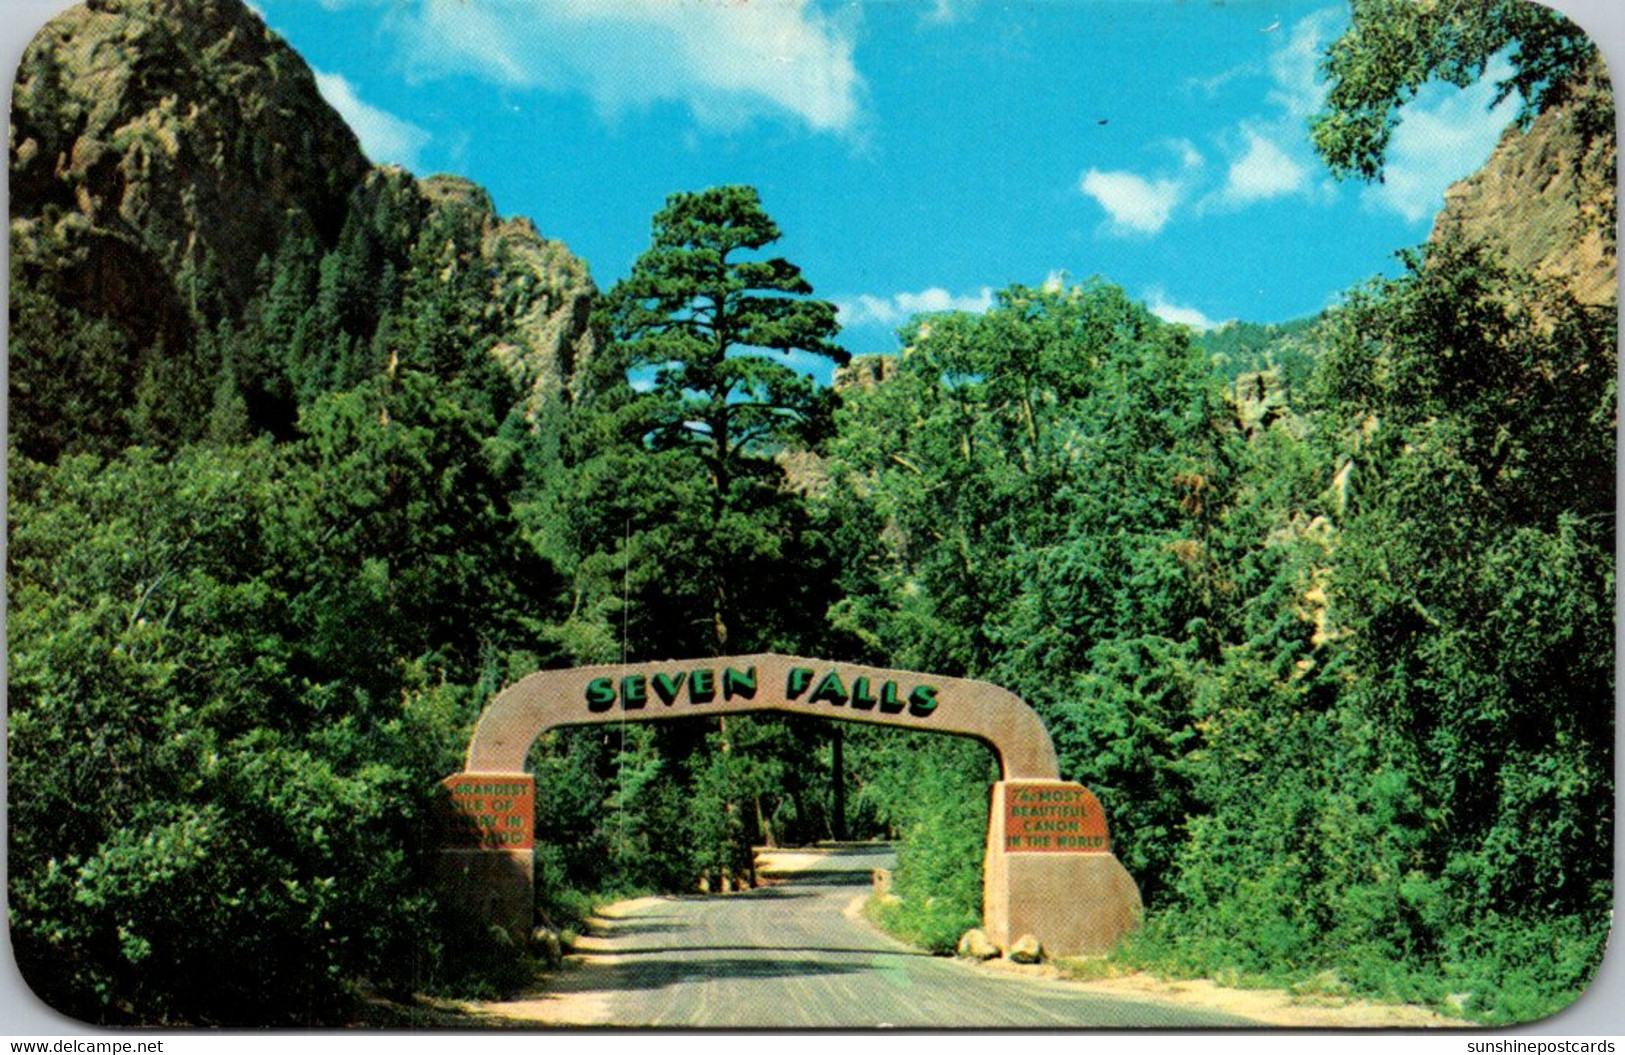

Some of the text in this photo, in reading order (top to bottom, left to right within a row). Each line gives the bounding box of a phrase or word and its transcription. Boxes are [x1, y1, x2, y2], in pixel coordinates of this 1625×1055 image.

[585, 666, 938, 717] SEVEN FALLS
[454, 783, 527, 796] GRANDEST
[1038, 789, 1081, 802] MOST
[492, 799, 514, 812] OF
[1011, 805, 1089, 818] BEAUTIFUL
[505, 815, 523, 828] IN
[1005, 835, 1104, 847] IN THE WORLD
